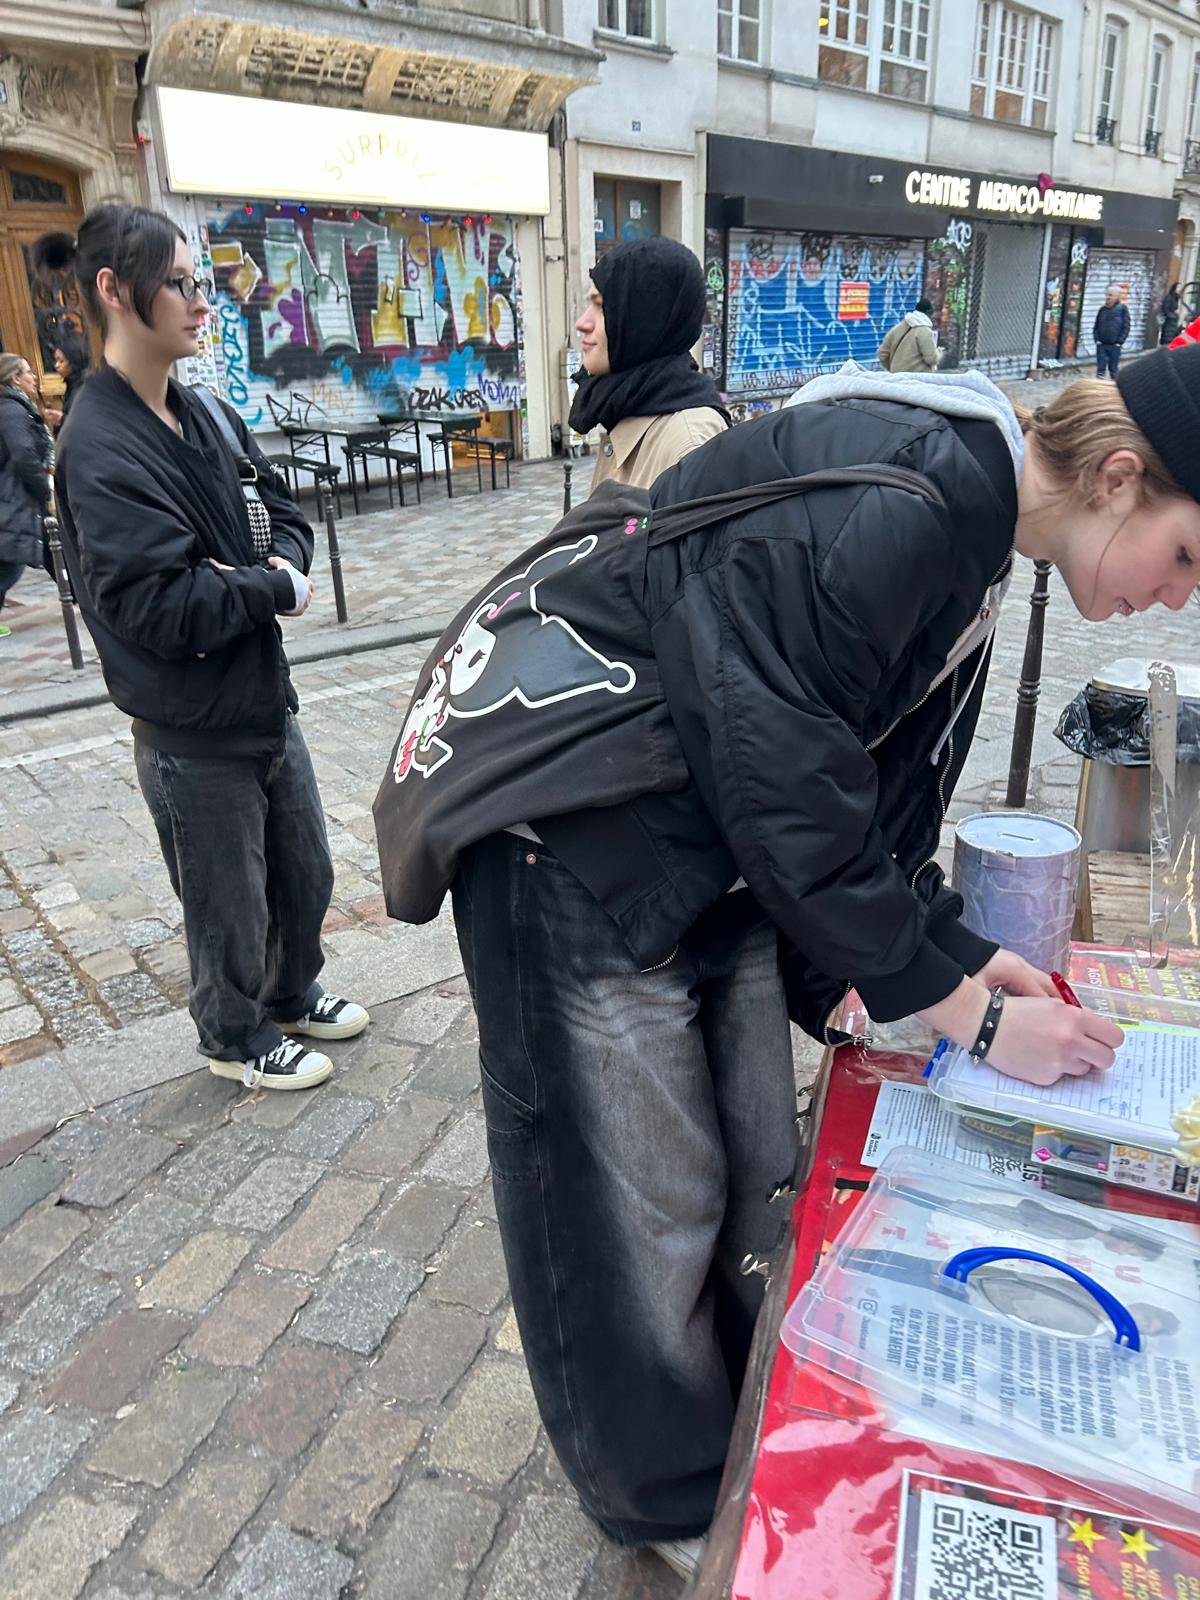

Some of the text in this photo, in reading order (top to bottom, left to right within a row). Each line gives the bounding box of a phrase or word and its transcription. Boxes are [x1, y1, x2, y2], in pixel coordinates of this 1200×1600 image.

[905, 170, 971, 208] CENTRE
[942, 1361, 957, 1384] pour
[1020, 1386, 1035, 1398] 15
[1077, 1554, 1091, 1585] SIGN
[1149, 1569, 1165, 1598] VISIT
